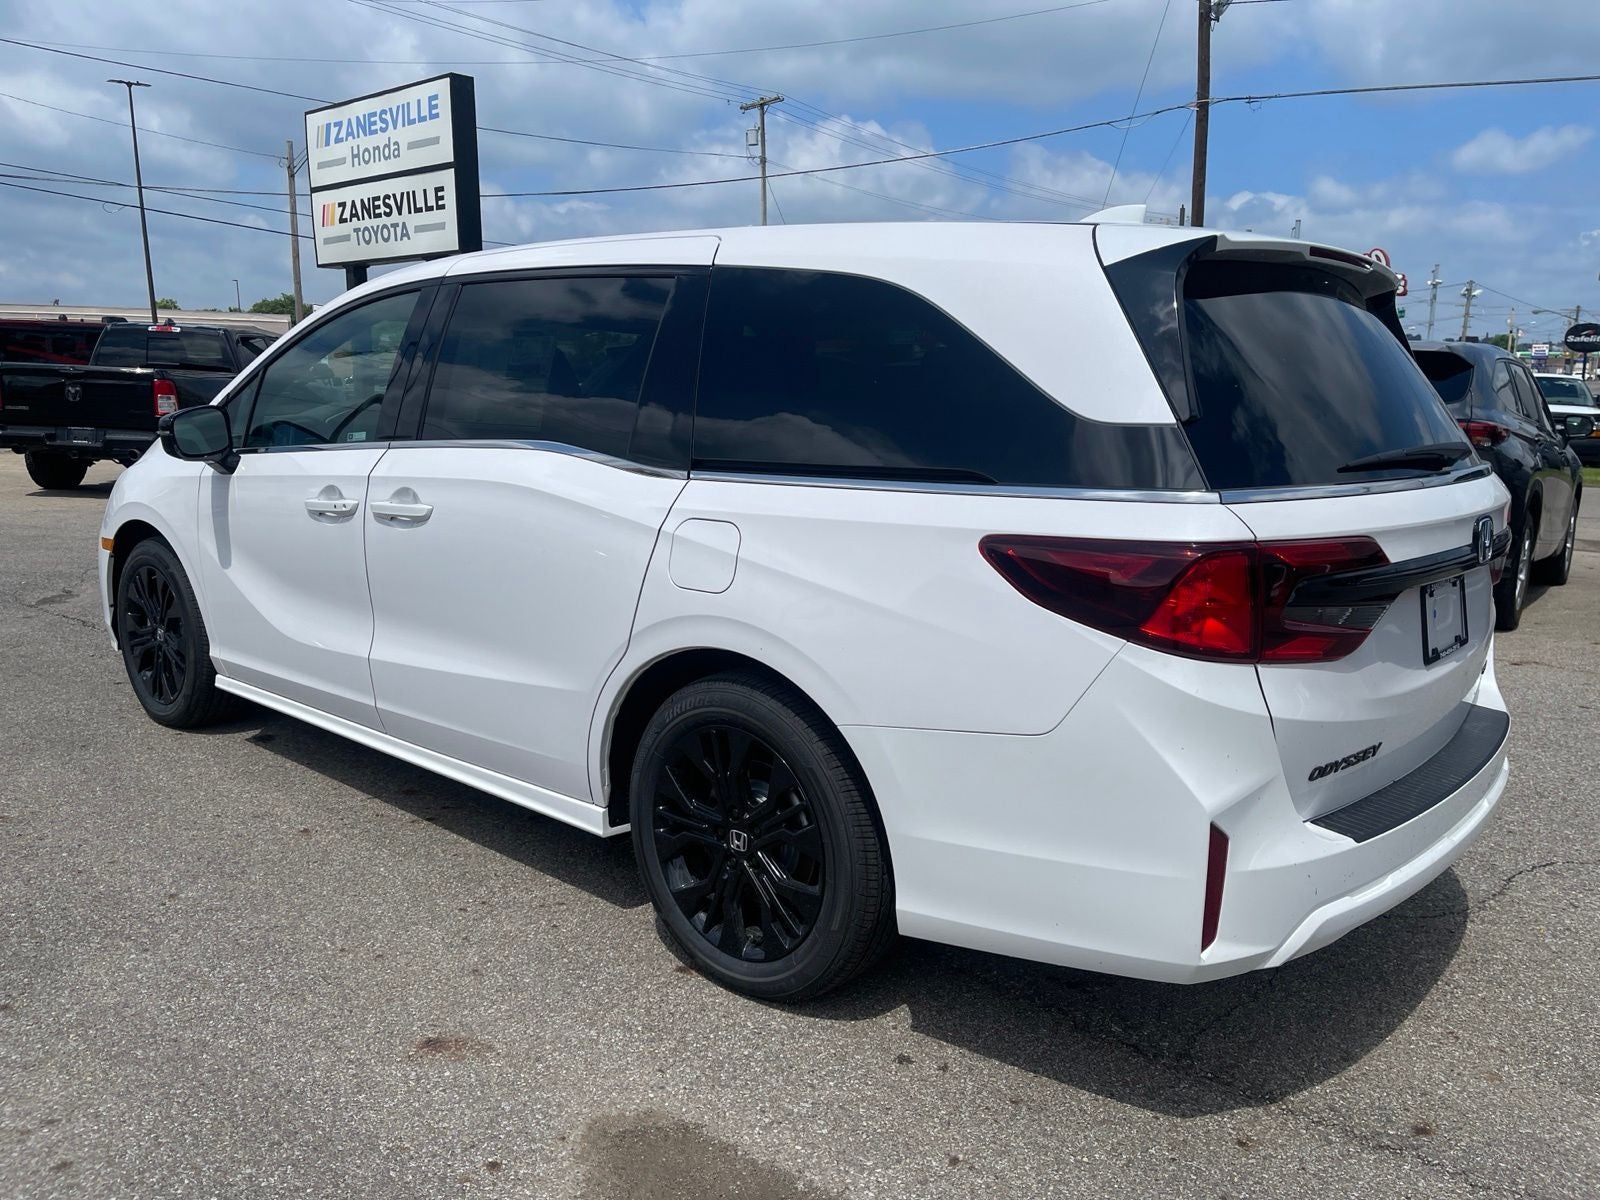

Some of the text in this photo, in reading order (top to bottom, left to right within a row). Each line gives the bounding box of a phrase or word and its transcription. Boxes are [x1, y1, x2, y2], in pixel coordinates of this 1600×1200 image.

[333, 94, 440, 145] ZANESVILLE
[351, 137, 401, 168] Honda
[338, 186, 446, 224] ZANESVILLE
[353, 221, 411, 246] TOYOTA
[1308, 742, 1383, 782] ODYSSEY
